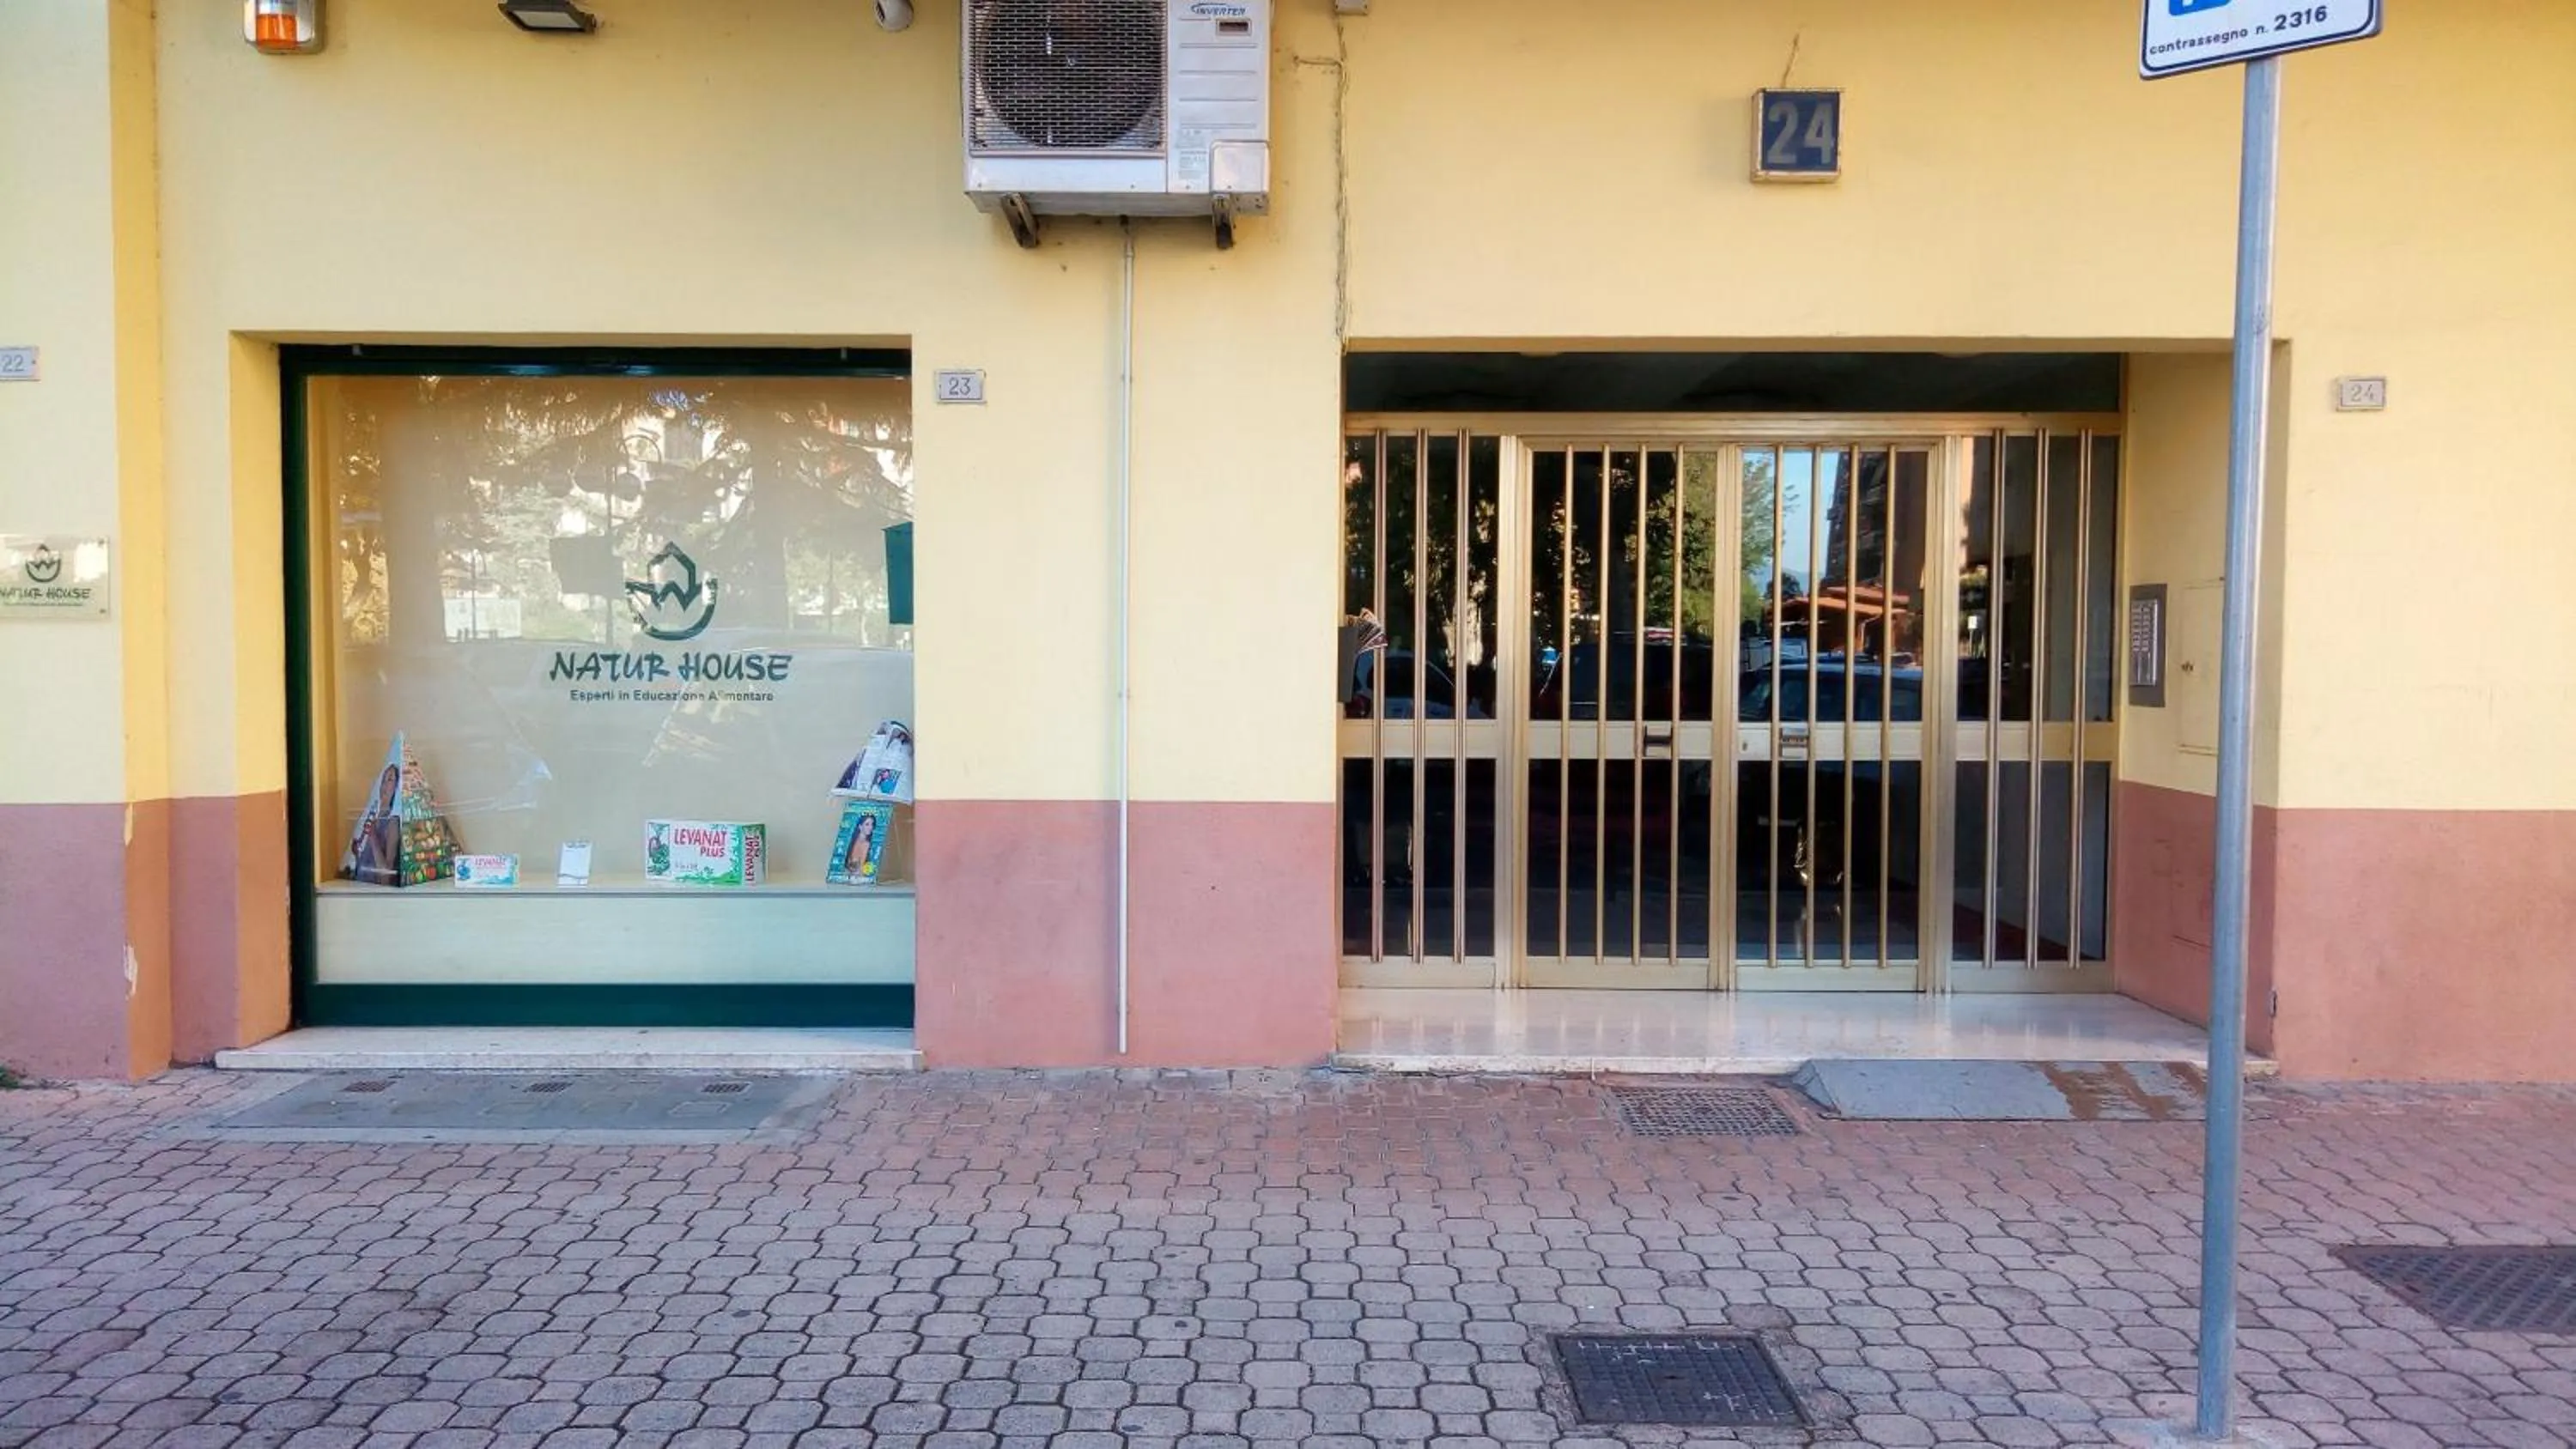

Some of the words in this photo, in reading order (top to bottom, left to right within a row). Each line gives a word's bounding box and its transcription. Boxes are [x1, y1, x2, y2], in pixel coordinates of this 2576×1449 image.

[2149, 27, 2248, 55] contrassegno
[2256, 25, 2269, 35] n.
[2275, 6, 2328, 31] 2316
[1767, 101, 1833, 164] 24
[1, 355, 25, 372] 22
[949, 378, 971, 395] 23
[2351, 384, 2374, 402] 24
[46, 587, 92, 599] HOUSE
[550, 651, 670, 682] NATUR
[677, 651, 793, 682] HOUSE
[570, 689, 615, 702] Esperti
[618, 689, 629, 700] in
[674, 828, 726, 846] LEVANAT
[700, 846, 726, 858] PLUS
[745, 834, 755, 882] LEVANAT
